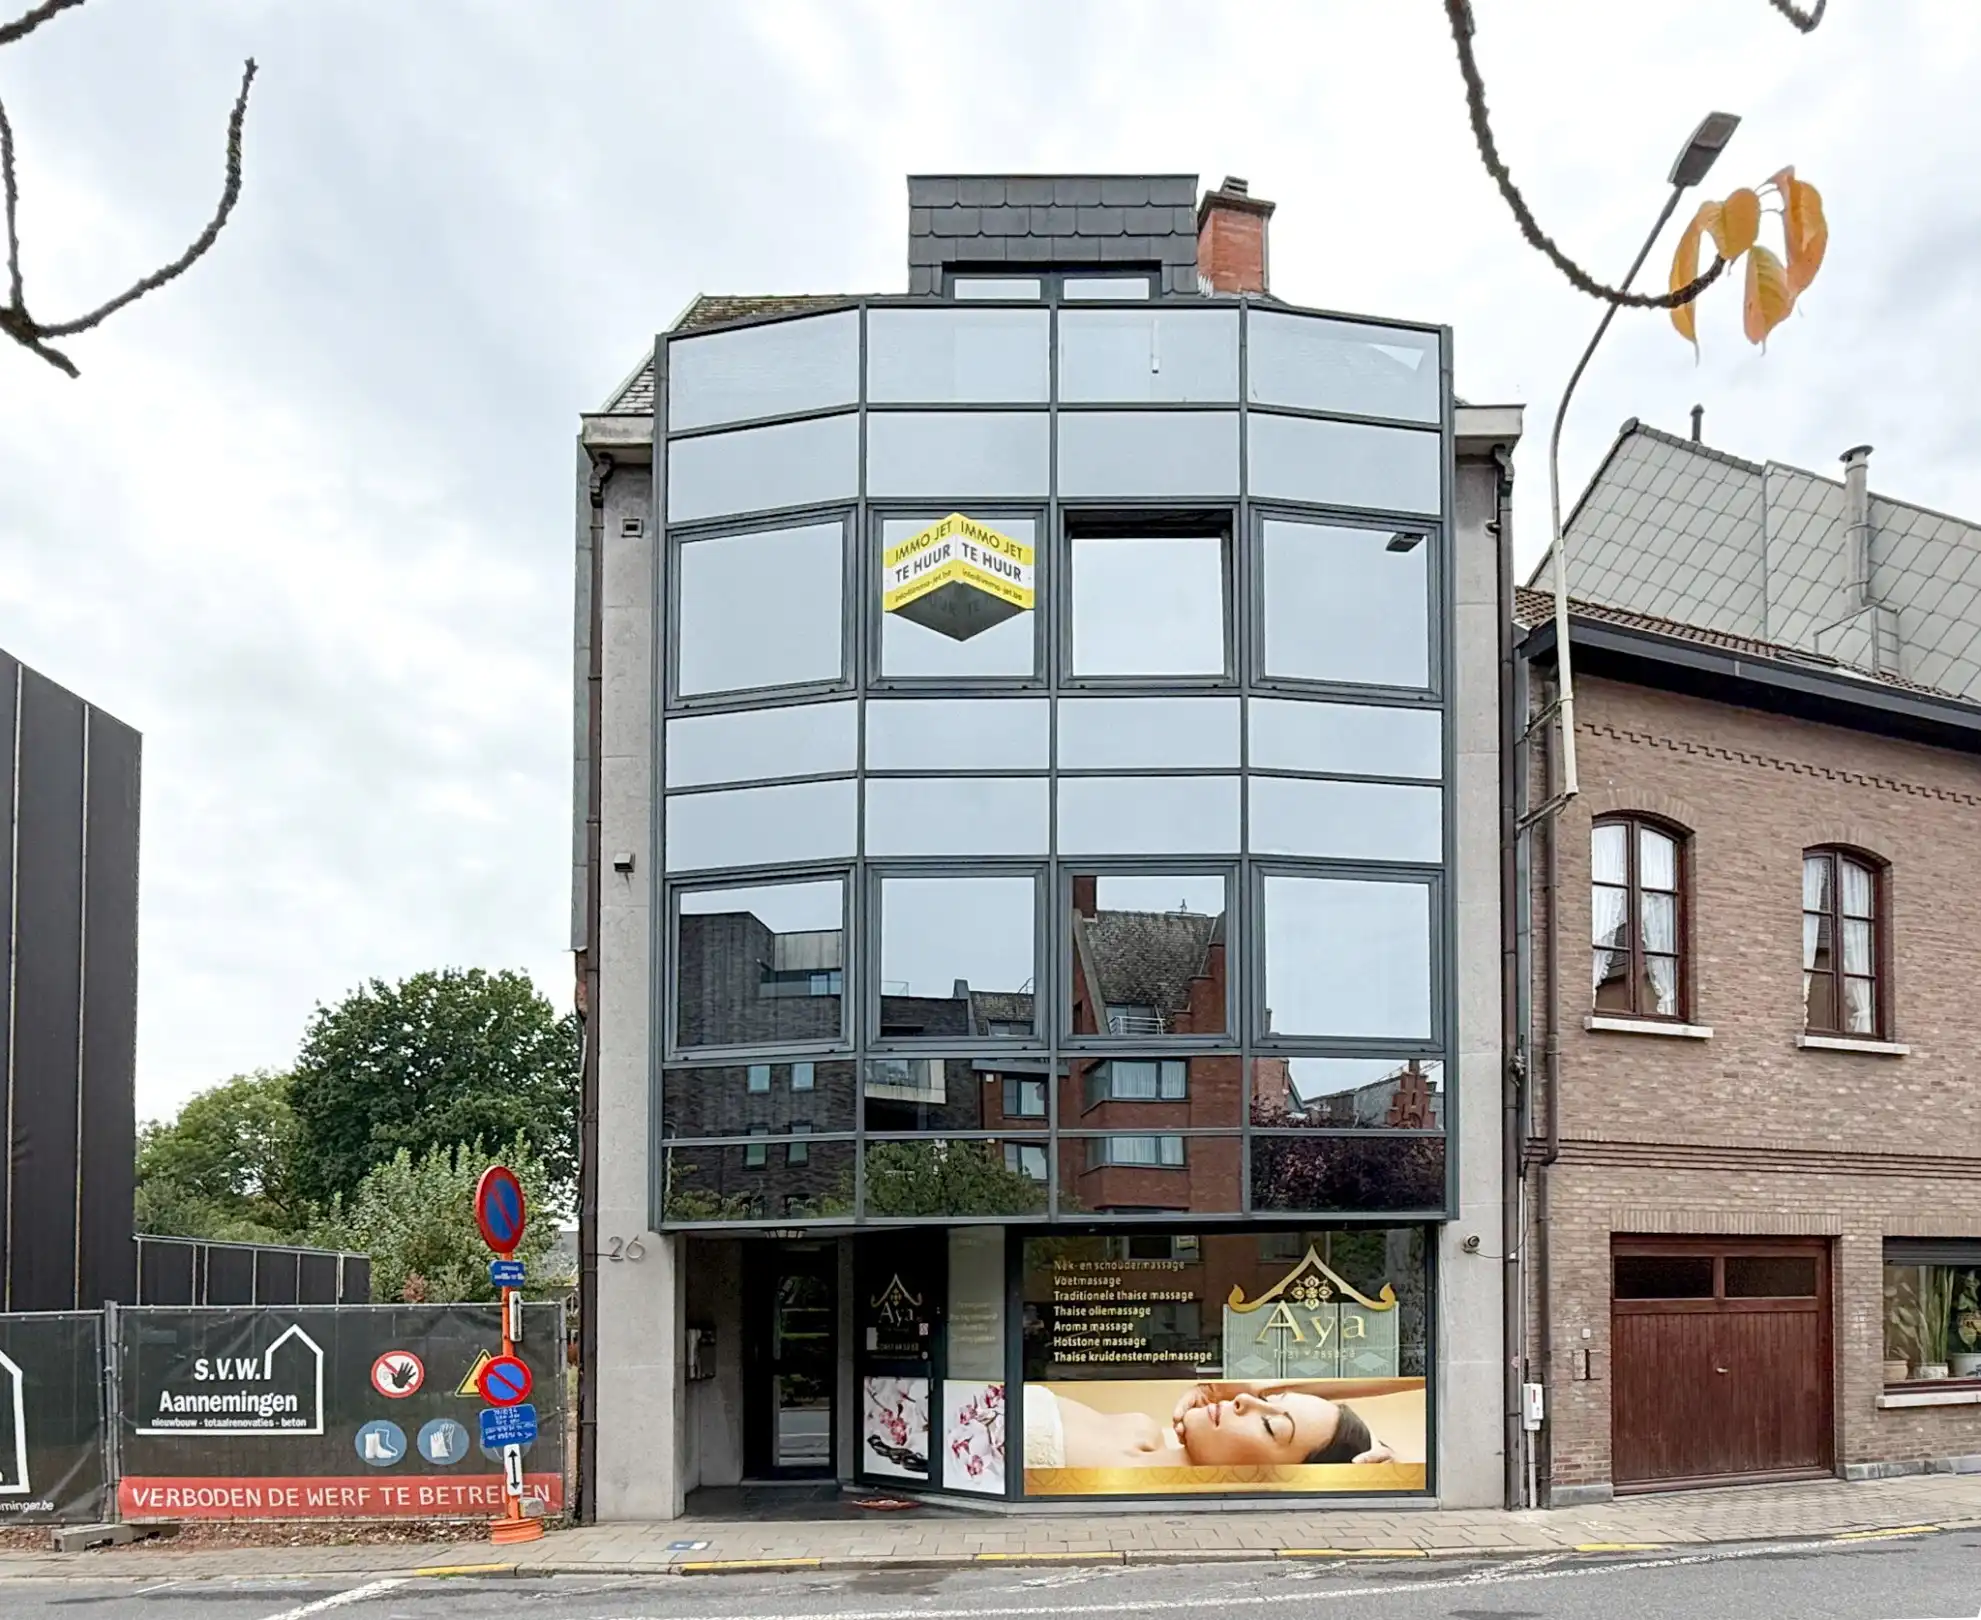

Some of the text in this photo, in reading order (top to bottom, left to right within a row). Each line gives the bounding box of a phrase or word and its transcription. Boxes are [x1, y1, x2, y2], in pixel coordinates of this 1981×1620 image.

[895, 520, 953, 562] IMMO JET
[961, 521, 1023, 559] IMMO JET
[895, 543, 952, 583] TE HUUR
[961, 542, 1022, 582] TE HUUR
[608, 1234, 646, 1262] 26
[1079, 1261, 1093, 1270] en
[1094, 1259, 1185, 1272] schoudermassage
[1053, 1276, 1122, 1288] Voetmassage
[1053, 1290, 1194, 1302] Traditionele thaise massage
[878, 1301, 914, 1328] Aya
[1053, 1305, 1151, 1318] Thaise oliemassage
[1053, 1321, 1134, 1333] Aroma massage
[1255, 1299, 1367, 1348] Aya
[1053, 1336, 1147, 1349] Hotstone massage
[1053, 1350, 1213, 1364] Thaise kruidenstempelmassage
[194, 1358, 261, 1381] S.V.W.
[159, 1390, 298, 1417] Aannemingen
[152, 1417, 198, 1428] nieuwbouw
[203, 1417, 275, 1428] totaalrenovaties
[281, 1417, 307, 1428] beton
[132, 1484, 550, 1507] VERBODEN DE WERF TE BETREEN
